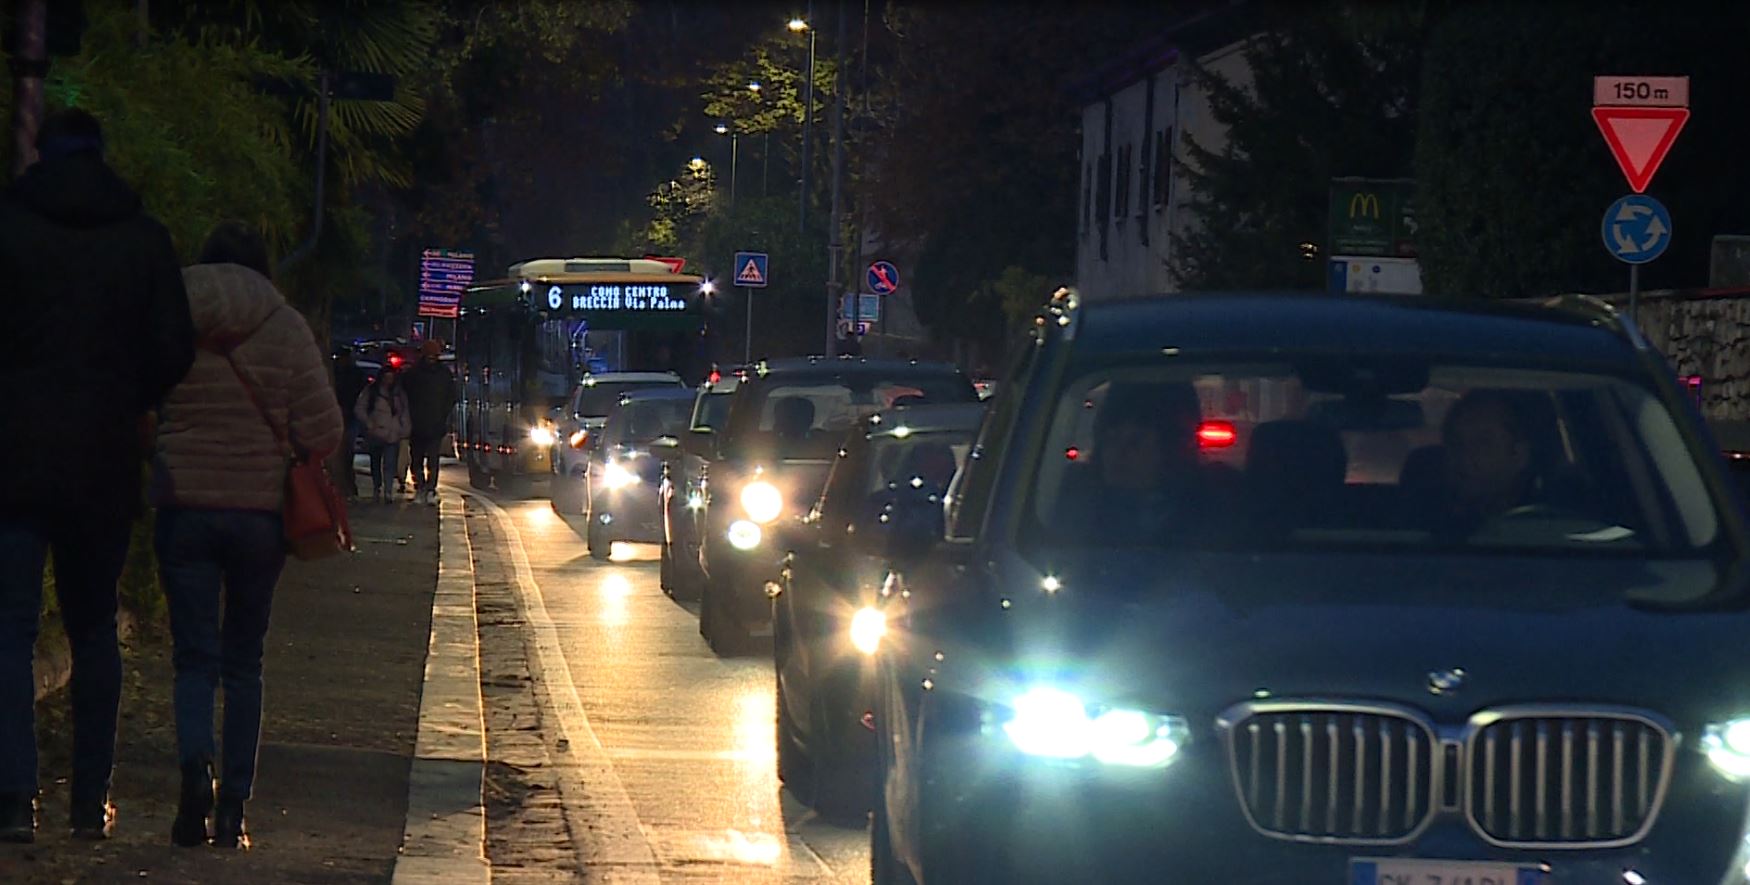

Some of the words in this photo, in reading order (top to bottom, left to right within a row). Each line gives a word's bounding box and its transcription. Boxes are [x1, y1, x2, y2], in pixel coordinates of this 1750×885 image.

[1614, 82, 1650, 99] 150
[1654, 88, 1669, 99] m
[548, 286, 562, 309] 6
[591, 286, 620, 297] COMO
[625, 286, 667, 297] CENTRO
[572, 296, 620, 309] BRECCIA
[625, 296, 645, 309] Via
